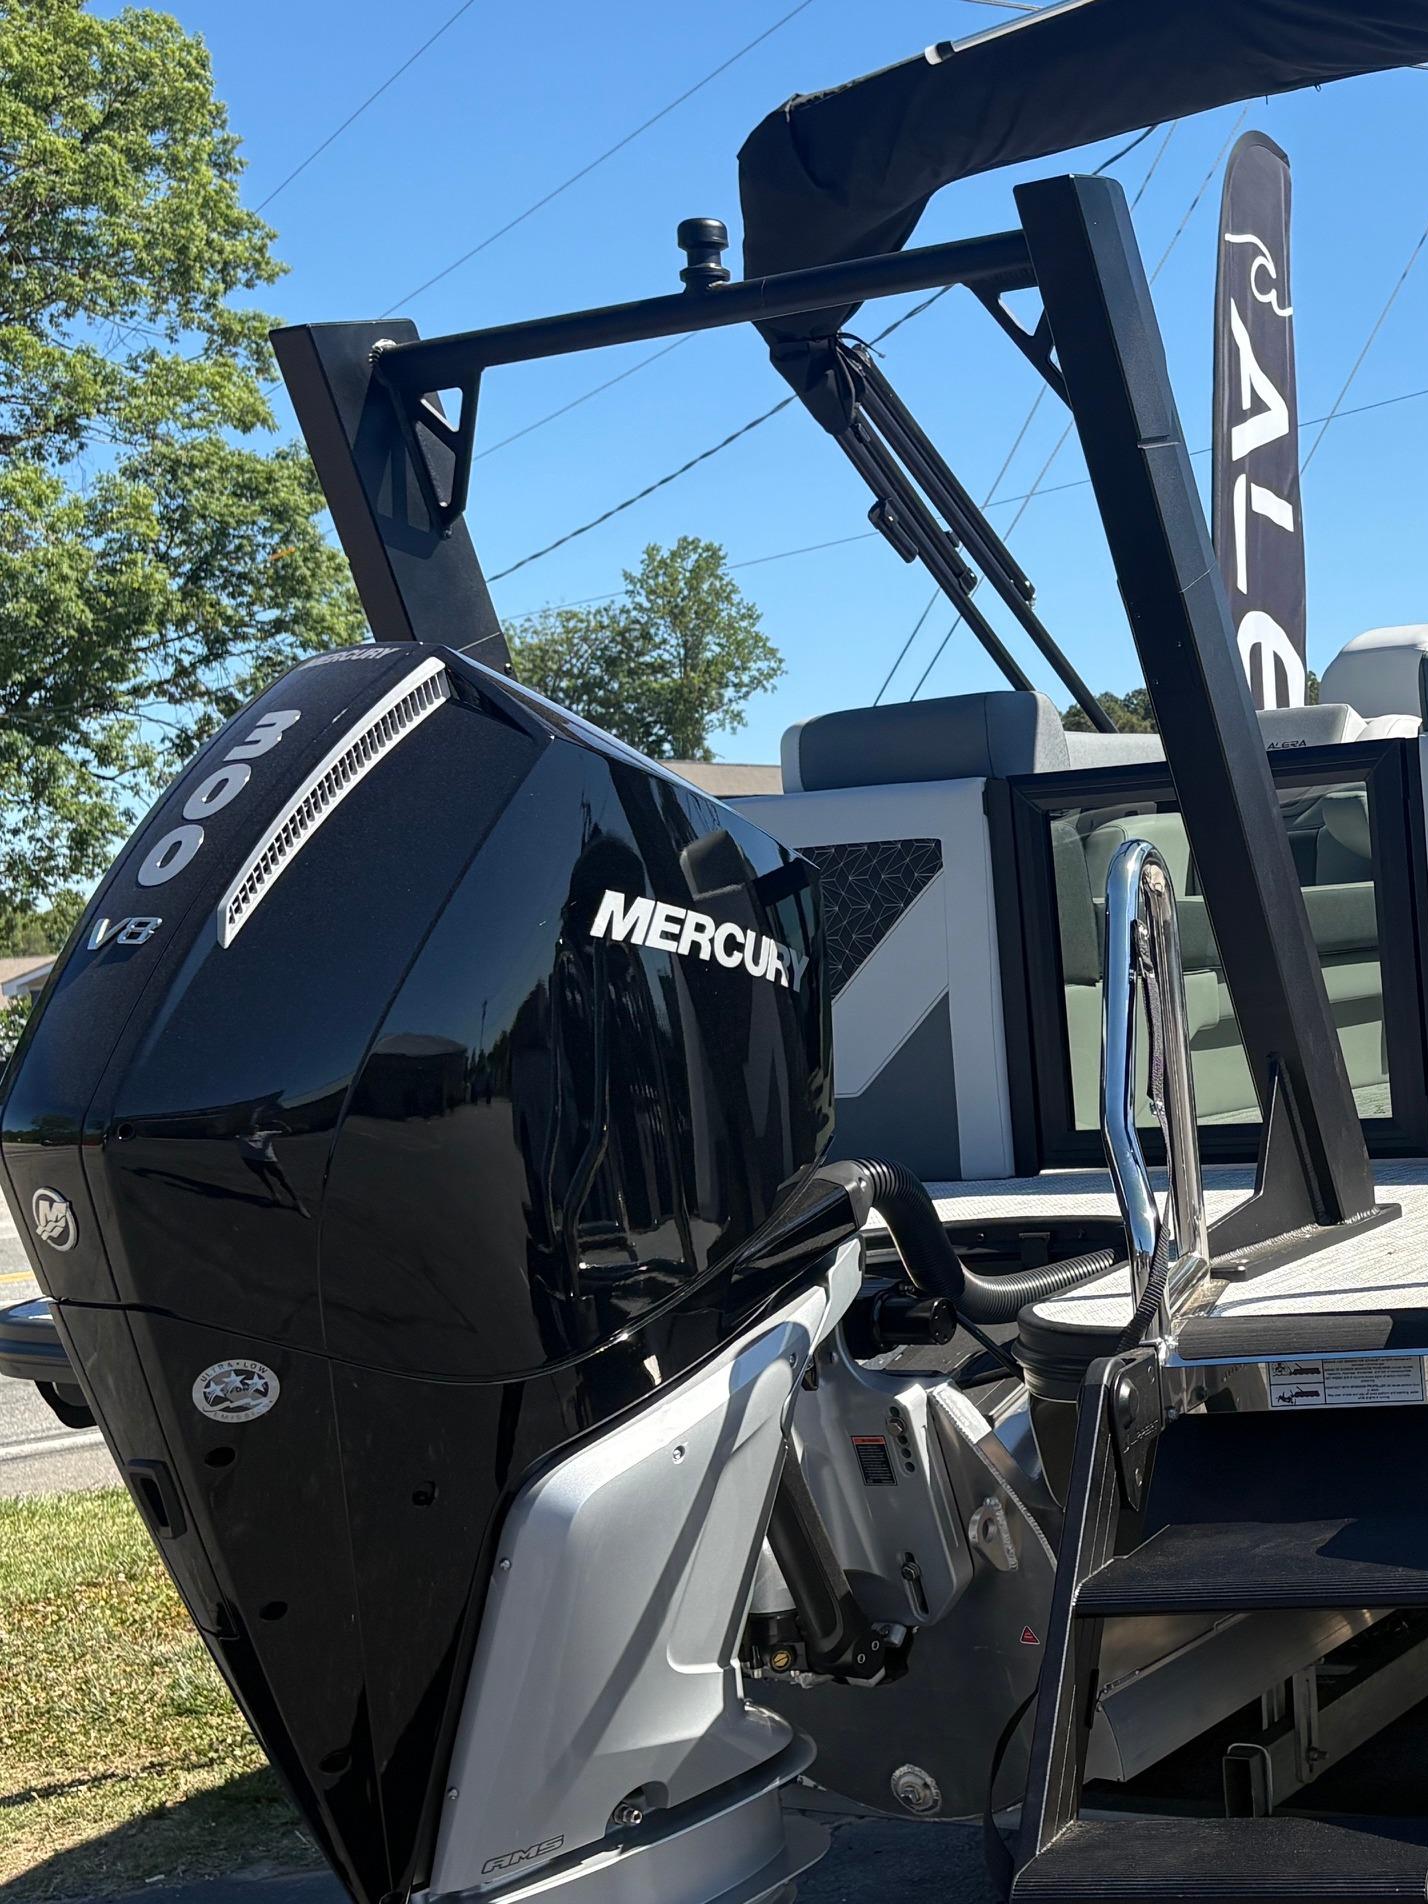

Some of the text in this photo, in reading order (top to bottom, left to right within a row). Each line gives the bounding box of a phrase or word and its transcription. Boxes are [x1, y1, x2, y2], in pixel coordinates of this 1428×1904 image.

[137, 709, 301, 887] 300
[87, 917, 162, 950] V8
[589, 889, 809, 993] MERCURY
[243, 1361, 268, 1374] LOW
[481, 1834, 565, 1875] AMS
